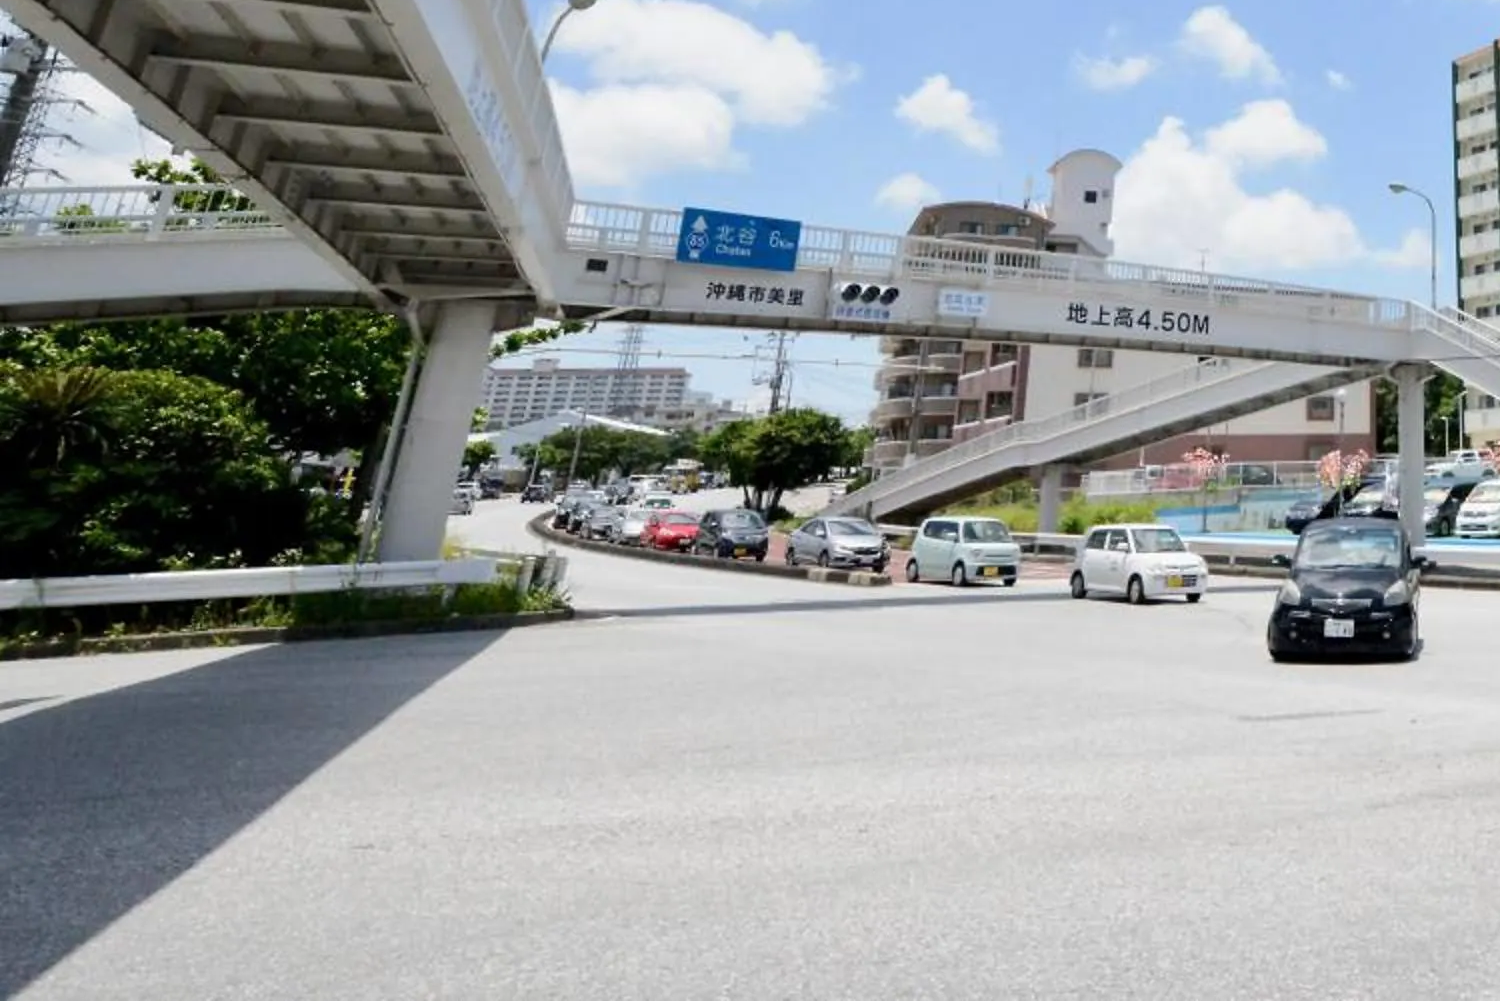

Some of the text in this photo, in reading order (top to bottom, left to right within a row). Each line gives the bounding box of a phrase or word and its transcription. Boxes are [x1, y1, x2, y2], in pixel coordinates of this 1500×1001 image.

[715, 225, 758, 246] 北谷
[705, 281, 805, 306] 沖縄市美里
[1066, 302, 1211, 335] 地上高4.50M
